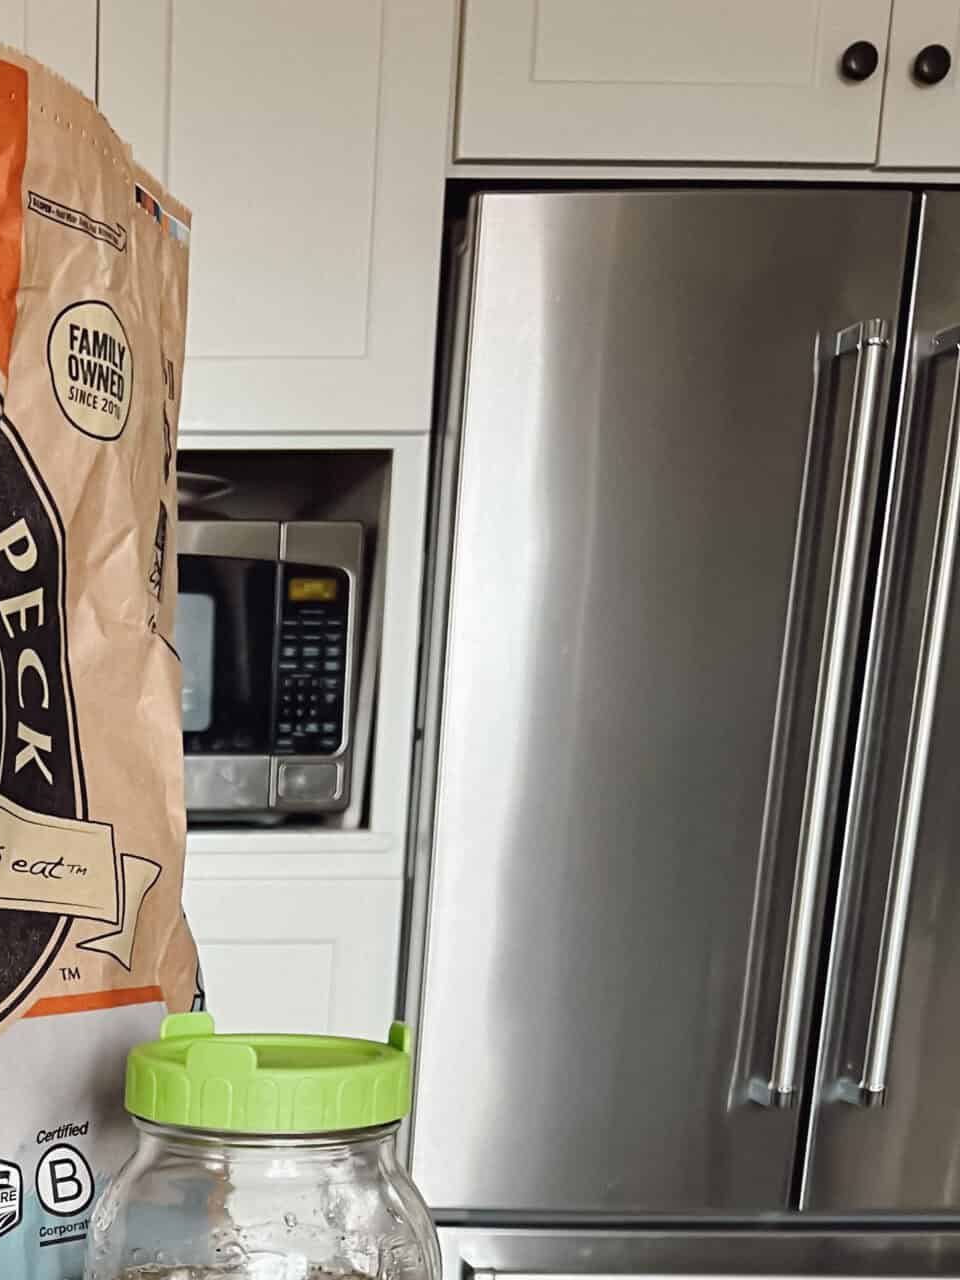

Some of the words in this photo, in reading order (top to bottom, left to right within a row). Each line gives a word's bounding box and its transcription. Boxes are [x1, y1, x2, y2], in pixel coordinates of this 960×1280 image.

[69, 323, 126, 371] FAMILY
[68, 353, 125, 402] OWNED
[68, 385, 98, 410] SINCE
[36, 1121, 89, 1144] Certified
[49, 1158, 83, 1204] B
[39, 1218, 88, 1238] Corporat
